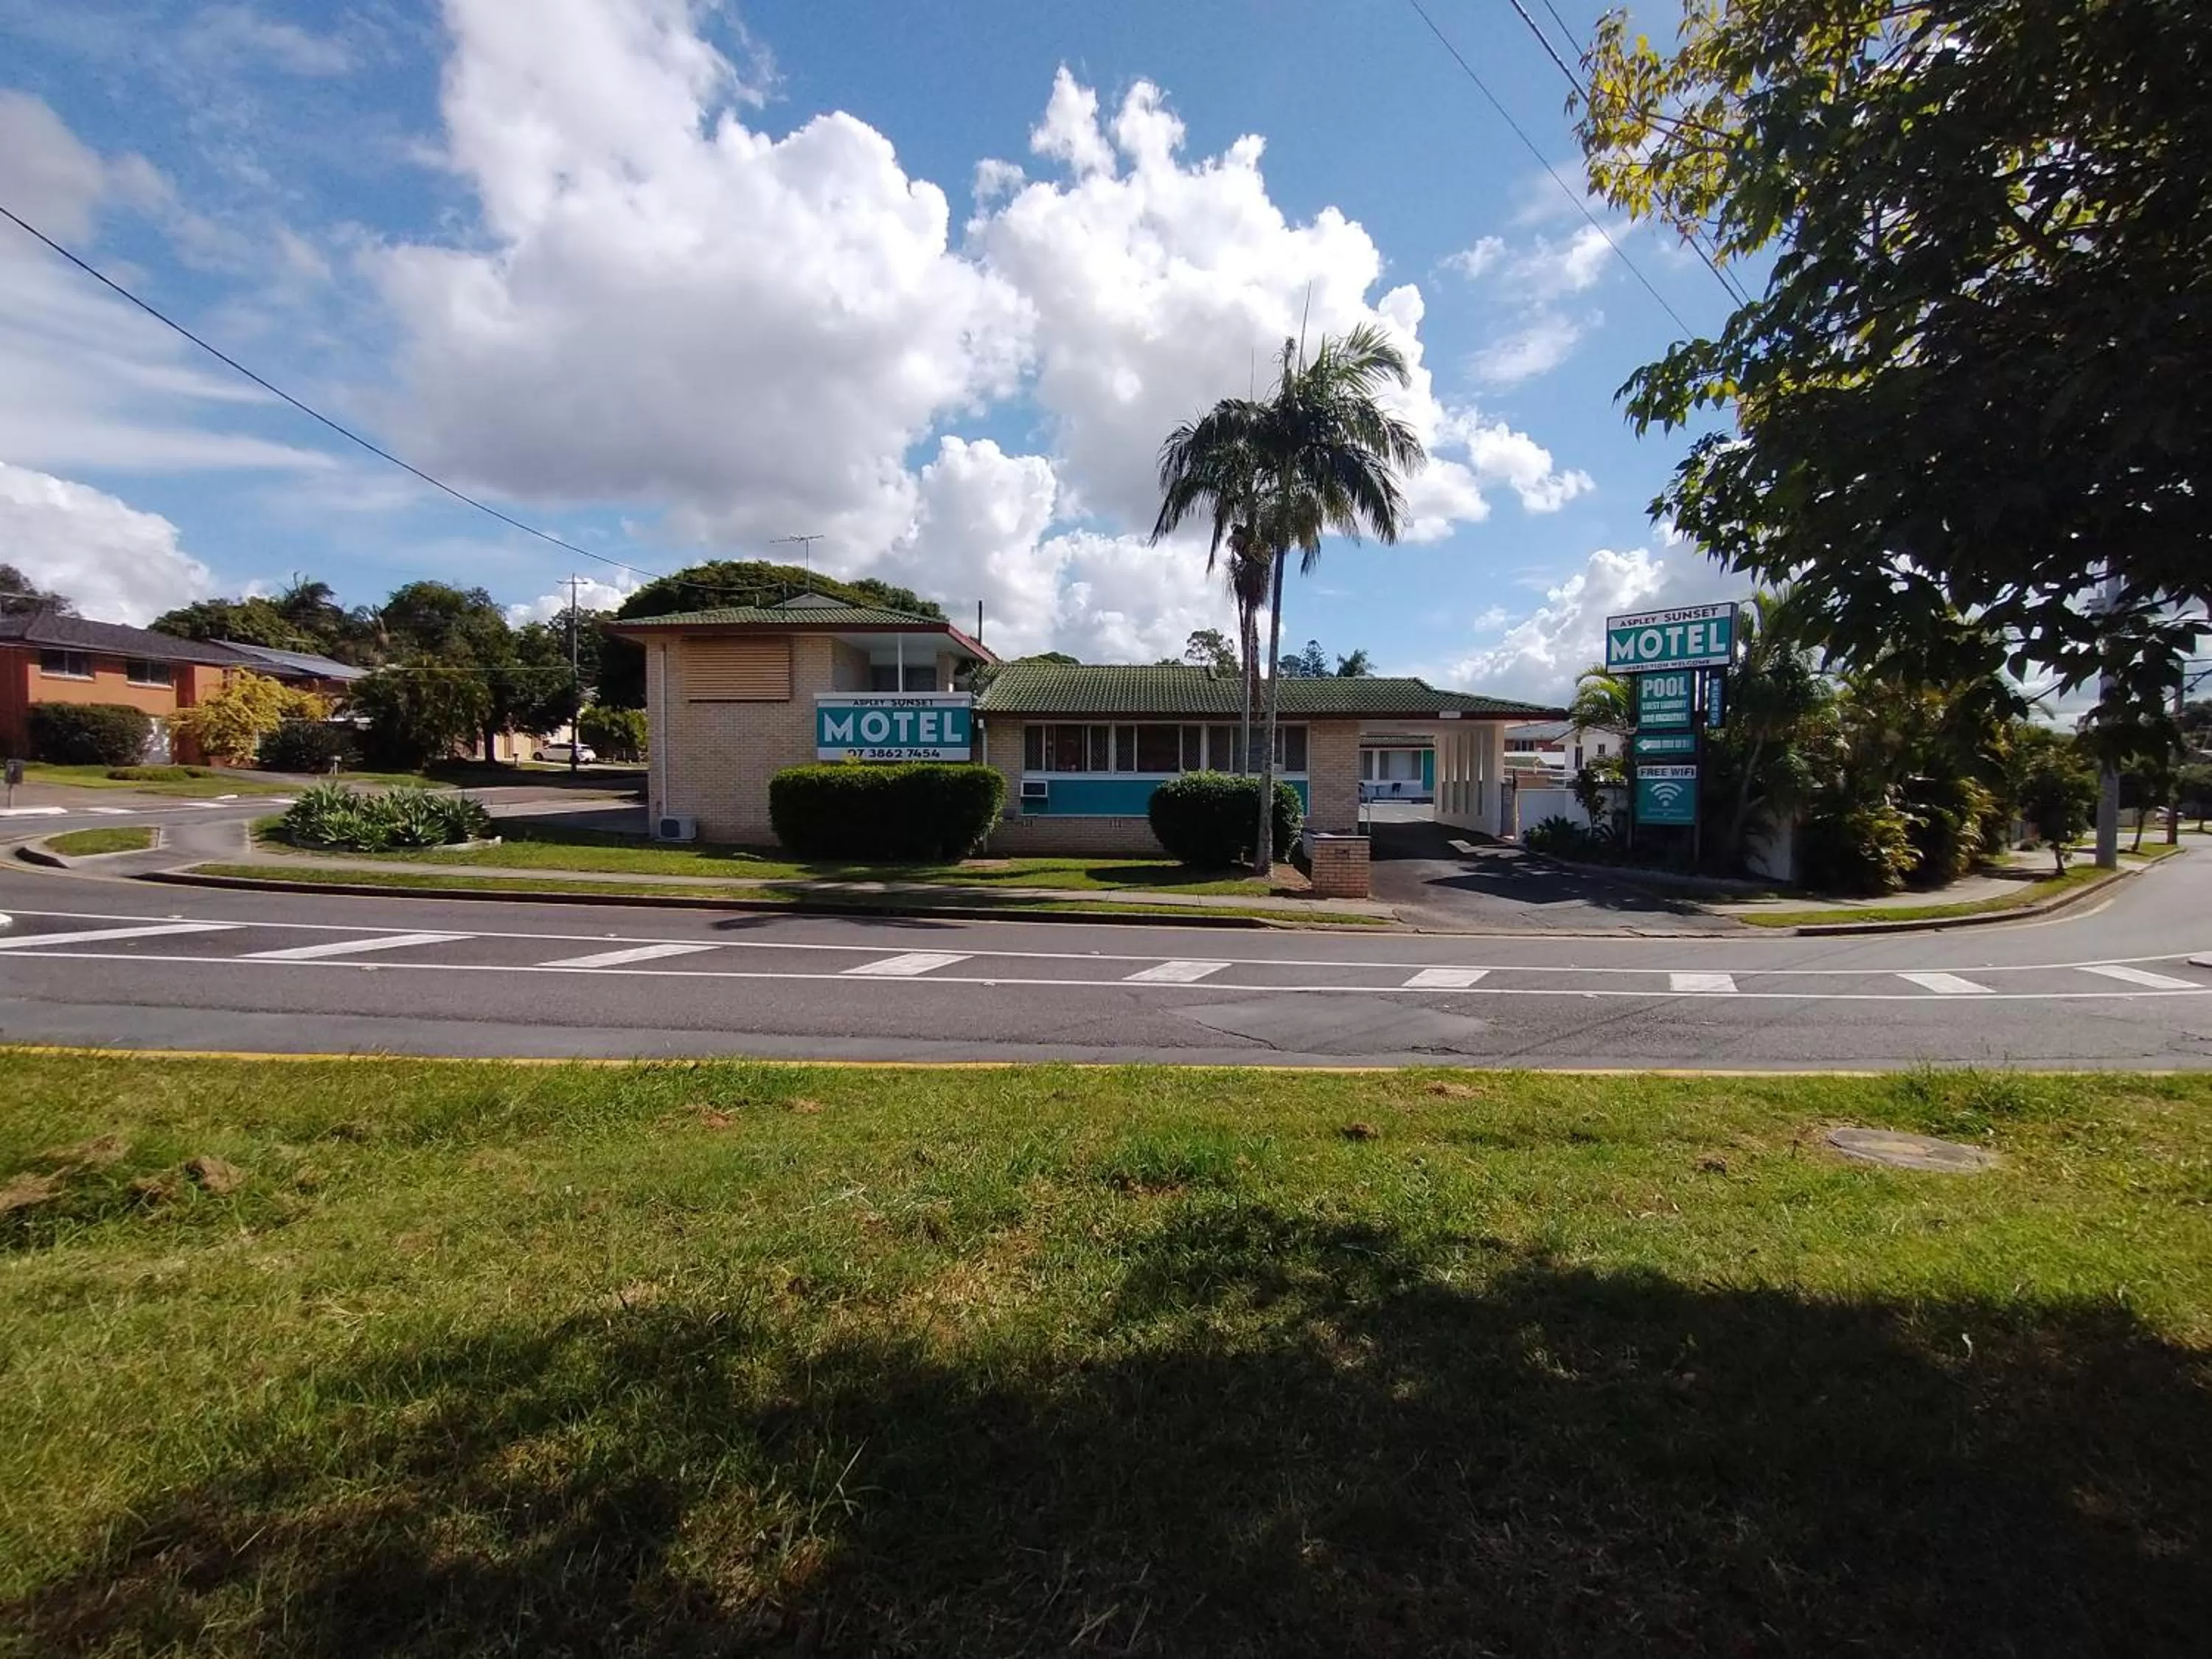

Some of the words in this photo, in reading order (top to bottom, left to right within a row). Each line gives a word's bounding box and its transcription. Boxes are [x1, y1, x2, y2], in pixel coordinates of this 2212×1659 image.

[1619, 615, 1656, 627] ASPLEY
[1664, 607, 1719, 622] SUNSET
[1611, 622, 1726, 661] MOTEL
[1671, 658, 1710, 668] WELCOME
[1642, 677, 1688, 698] POOL
[891, 698, 933, 706] SUNSET
[824, 711, 962, 742] MOTEL
[869, 748, 903, 758] 3862
[906, 748, 941, 758] 7454
[1641, 768, 1668, 776] FREE
[1671, 767, 1694, 776] WIFI
